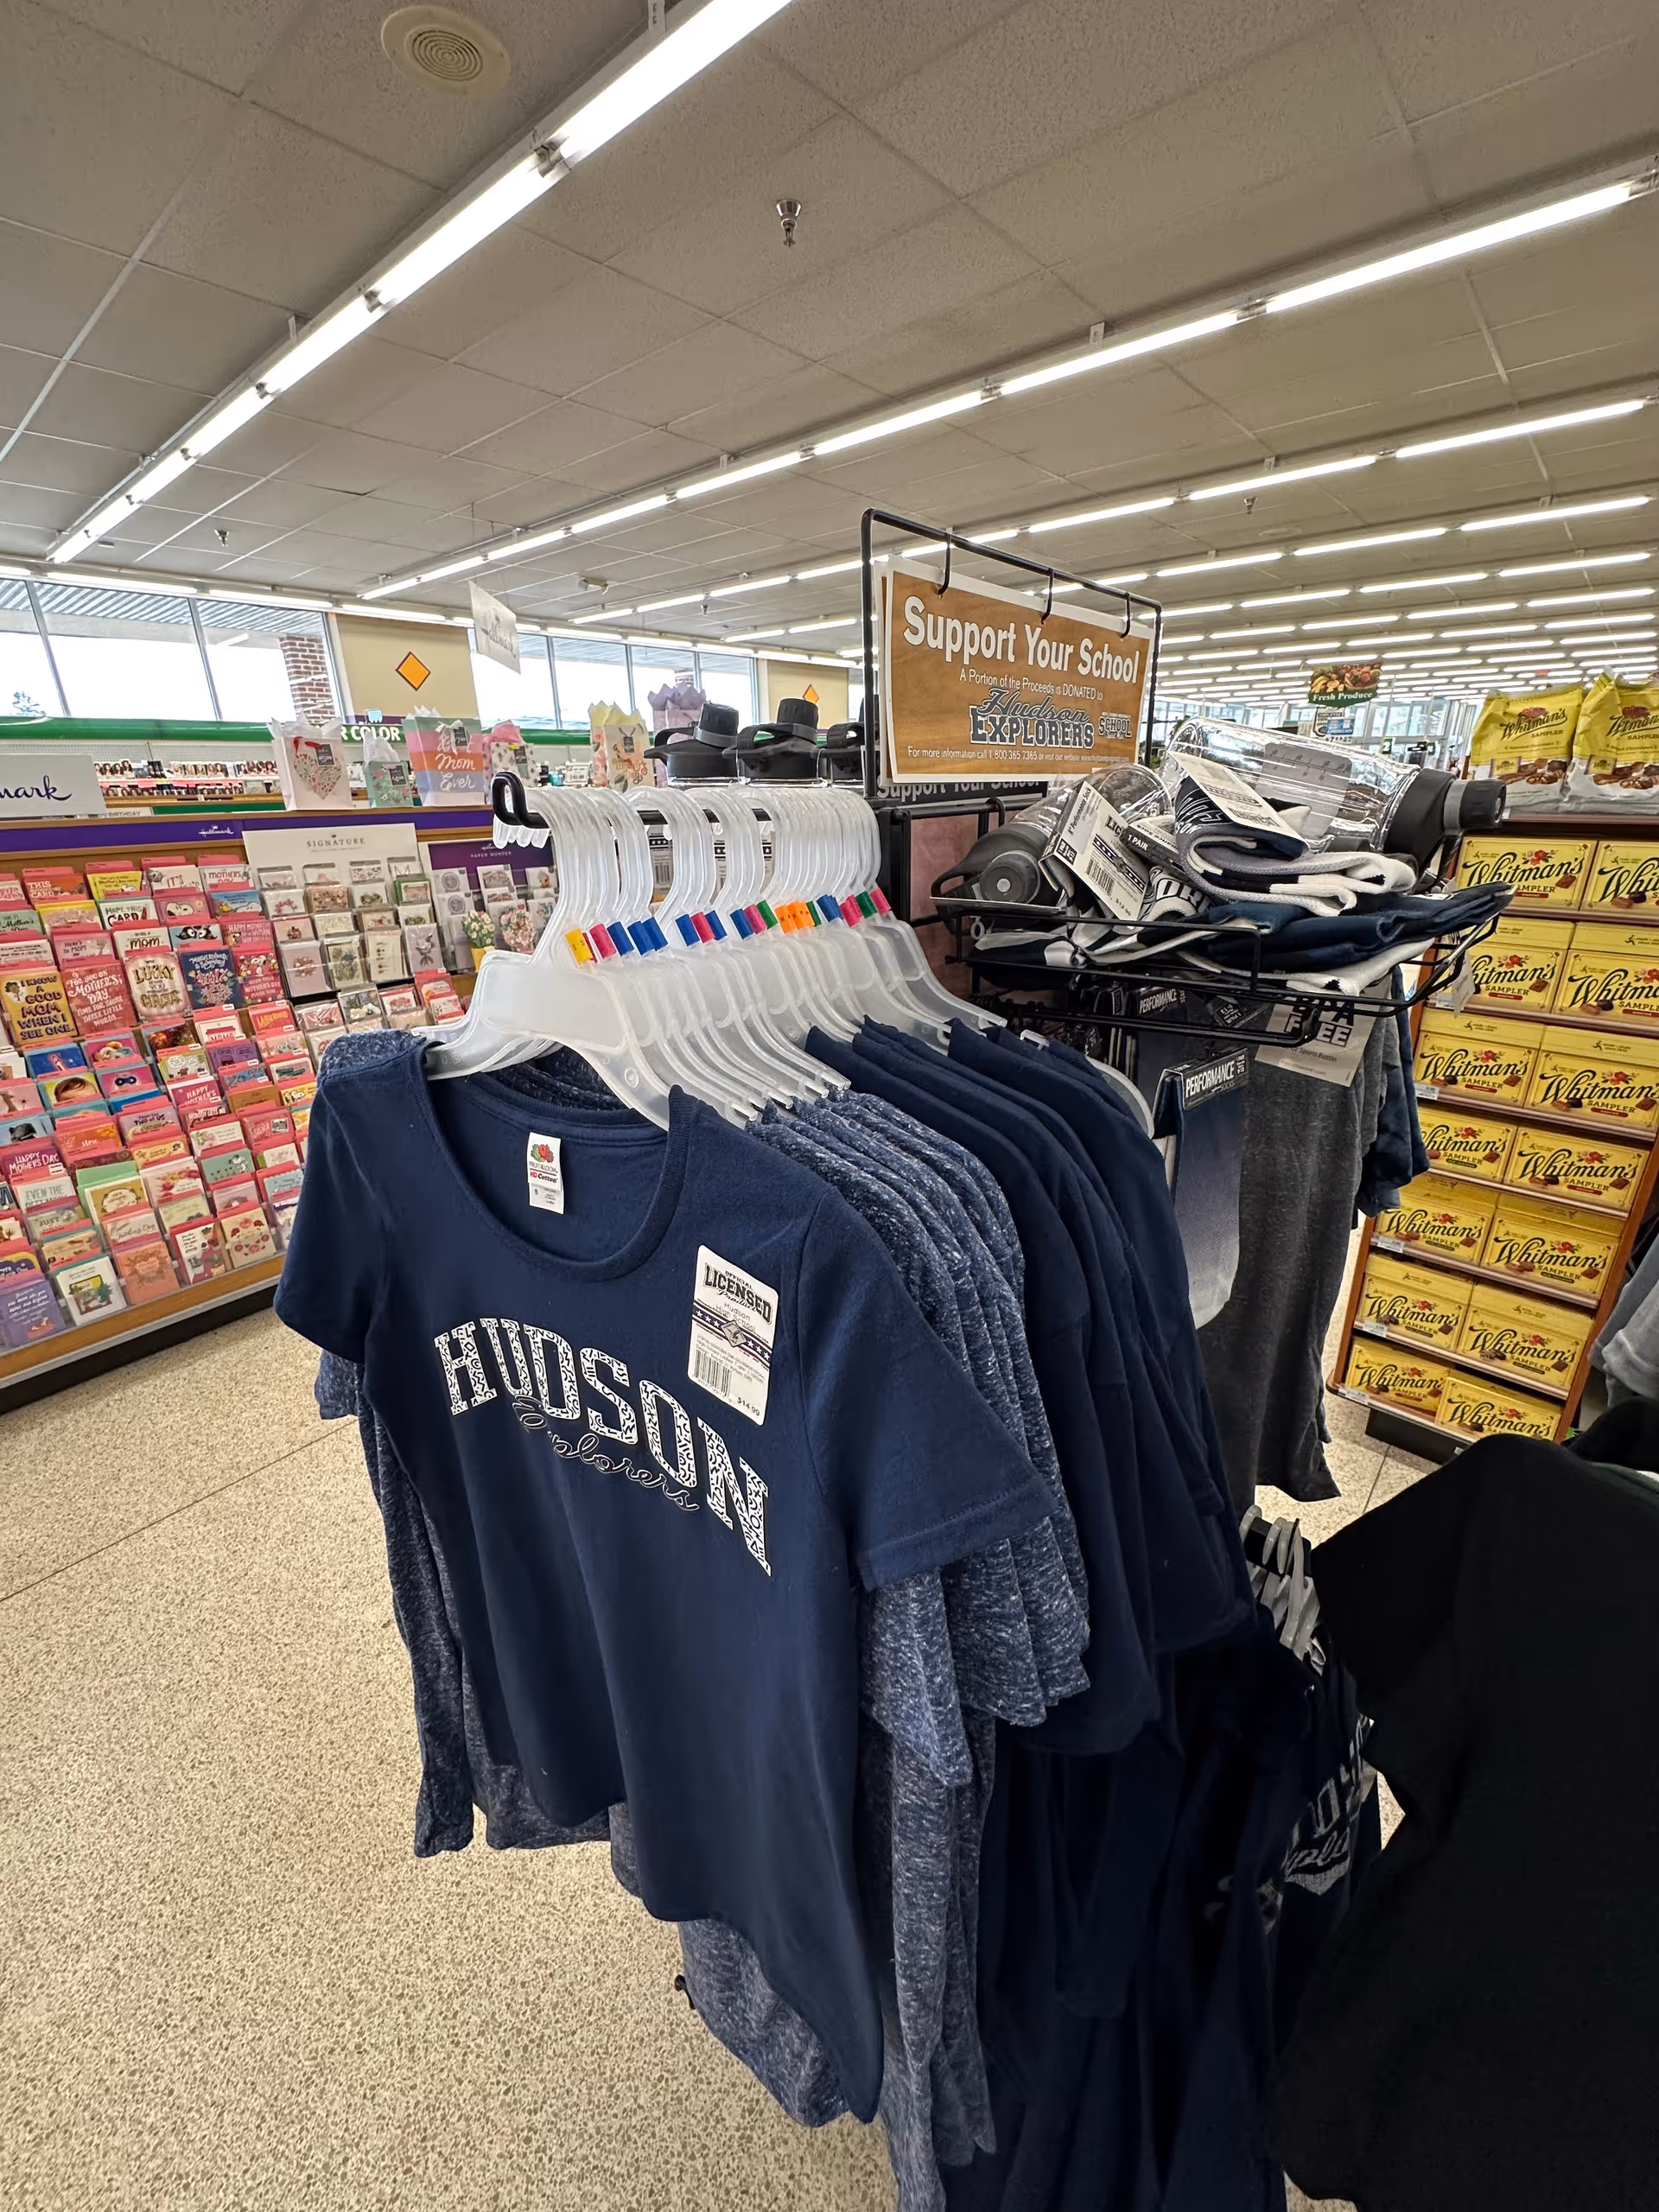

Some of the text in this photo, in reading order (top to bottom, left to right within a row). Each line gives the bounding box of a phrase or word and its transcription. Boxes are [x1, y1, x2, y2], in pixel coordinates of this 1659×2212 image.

[904, 595, 1140, 683] Support Your School
[959, 668, 1103, 700] A Portion of the Proceeds is DONATED to
[1313, 691, 1374, 702] Fresh Produce
[977, 687, 1090, 724] Hudson
[969, 706, 1095, 749] EXPLORERS
[1098, 715, 1132, 736] SCHOOL
[1499, 708, 1568, 741] Whitman's
[351, 726, 401, 741] COLOR
[1531, 730, 1564, 739] SAMPLER
[908, 747, 920, 758] For
[922, 749, 940, 758] more
[942, 749, 976, 760] information
[977, 750, 987, 759] call
[441, 772, 475, 791] Ever
[1071, 797, 1087, 829] Performance
[1084, 787, 1092, 801] Sock
[306, 837, 365, 848] SIGNATURE
[1132, 836, 1148, 851] PAIR
[1462, 852, 1585, 887] Whitman's
[27, 880, 52, 889] THIS
[167, 874, 184, 887] IT'S
[107, 912, 139, 924] CARD
[98, 970, 109, 979] ON
[132, 964, 176, 984] LUCKY
[1472, 955, 1557, 985] hitman's
[27, 976, 58, 987] KNOW
[1485, 984, 1529, 995] SAMPLER
[25, 991, 62, 1005] GOOD
[1139, 988, 1178, 1014] PERFORMANCE
[22, 1003, 61, 1018] MOM
[18, 1014, 67, 1029] WHEN I
[20, 1028, 42, 1040] SEE
[1284, 1014, 1352, 1048] FEE
[1299, 1046, 1318, 1058] Sports
[1318, 1052, 1337, 1062] Bottle
[1420, 1049, 1529, 1081] Whitman's
[1185, 1060, 1236, 1098] PERFORMANCE
[1461, 1077, 1503, 1090] SAMPLER
[183, 1090, 217, 1105] MOTHER'S
[187, 1085, 208, 1100] HAPPY
[1587, 1099, 1636, 1114] SAMPLER
[16, 1152, 59, 1166] HAPPY DAY
[529, 1161, 541, 1170] FRUIT
[1443, 1152, 1483, 1166] SAMPLER
[1517, 1149, 1639, 1180] Whitman's
[538, 1173, 558, 1184] Cotton
[1564, 1177, 1609, 1192] SAMPLER
[26, 1185, 65, 1201] EVEN THE
[39, 1217, 60, 1228] JUST
[1382, 1210, 1483, 1239] Whitman's
[1421, 1234, 1460, 1249] SAMPLER
[1494, 1237, 1607, 1269] Whitman's
[725, 1270, 753, 1289] OFFICIAL
[1537, 1264, 1581, 1281] SAMPLER
[703, 1263, 772, 1325] LICENSED
[717, 1288, 757, 1313] Product
[716, 1303, 756, 1332] High School
[724, 1301, 751, 1321] Hudson
[1365, 1293, 1459, 1327] Whitman's
[1401, 1320, 1440, 1335] SAMPLER
[1469, 1325, 1577, 1363] Whitman's
[1510, 1355, 1551, 1372] SAMPLER
[1392, 1386, 1427, 1399] SAMPLER
[736, 1396, 760, 1417] $14.99
[1447, 1398, 1551, 1437] Whitman's
[434, 1318, 772, 1576] HUDSON
